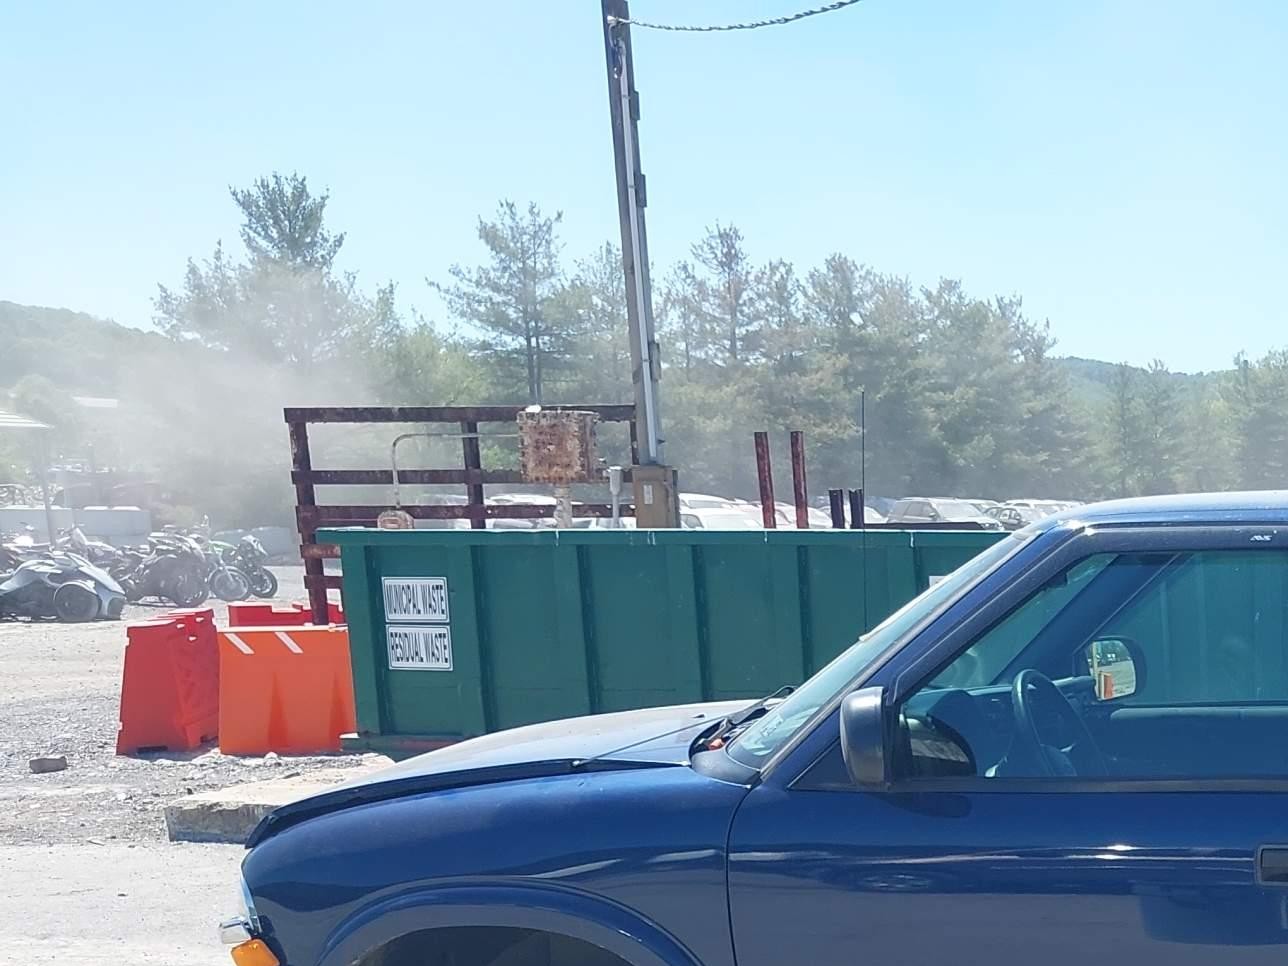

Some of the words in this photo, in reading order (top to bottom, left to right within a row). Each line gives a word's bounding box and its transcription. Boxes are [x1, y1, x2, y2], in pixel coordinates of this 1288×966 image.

[420, 583, 446, 615] WASTE
[389, 631, 424, 663] RESIDUAL
[422, 631, 449, 664] WASTE
